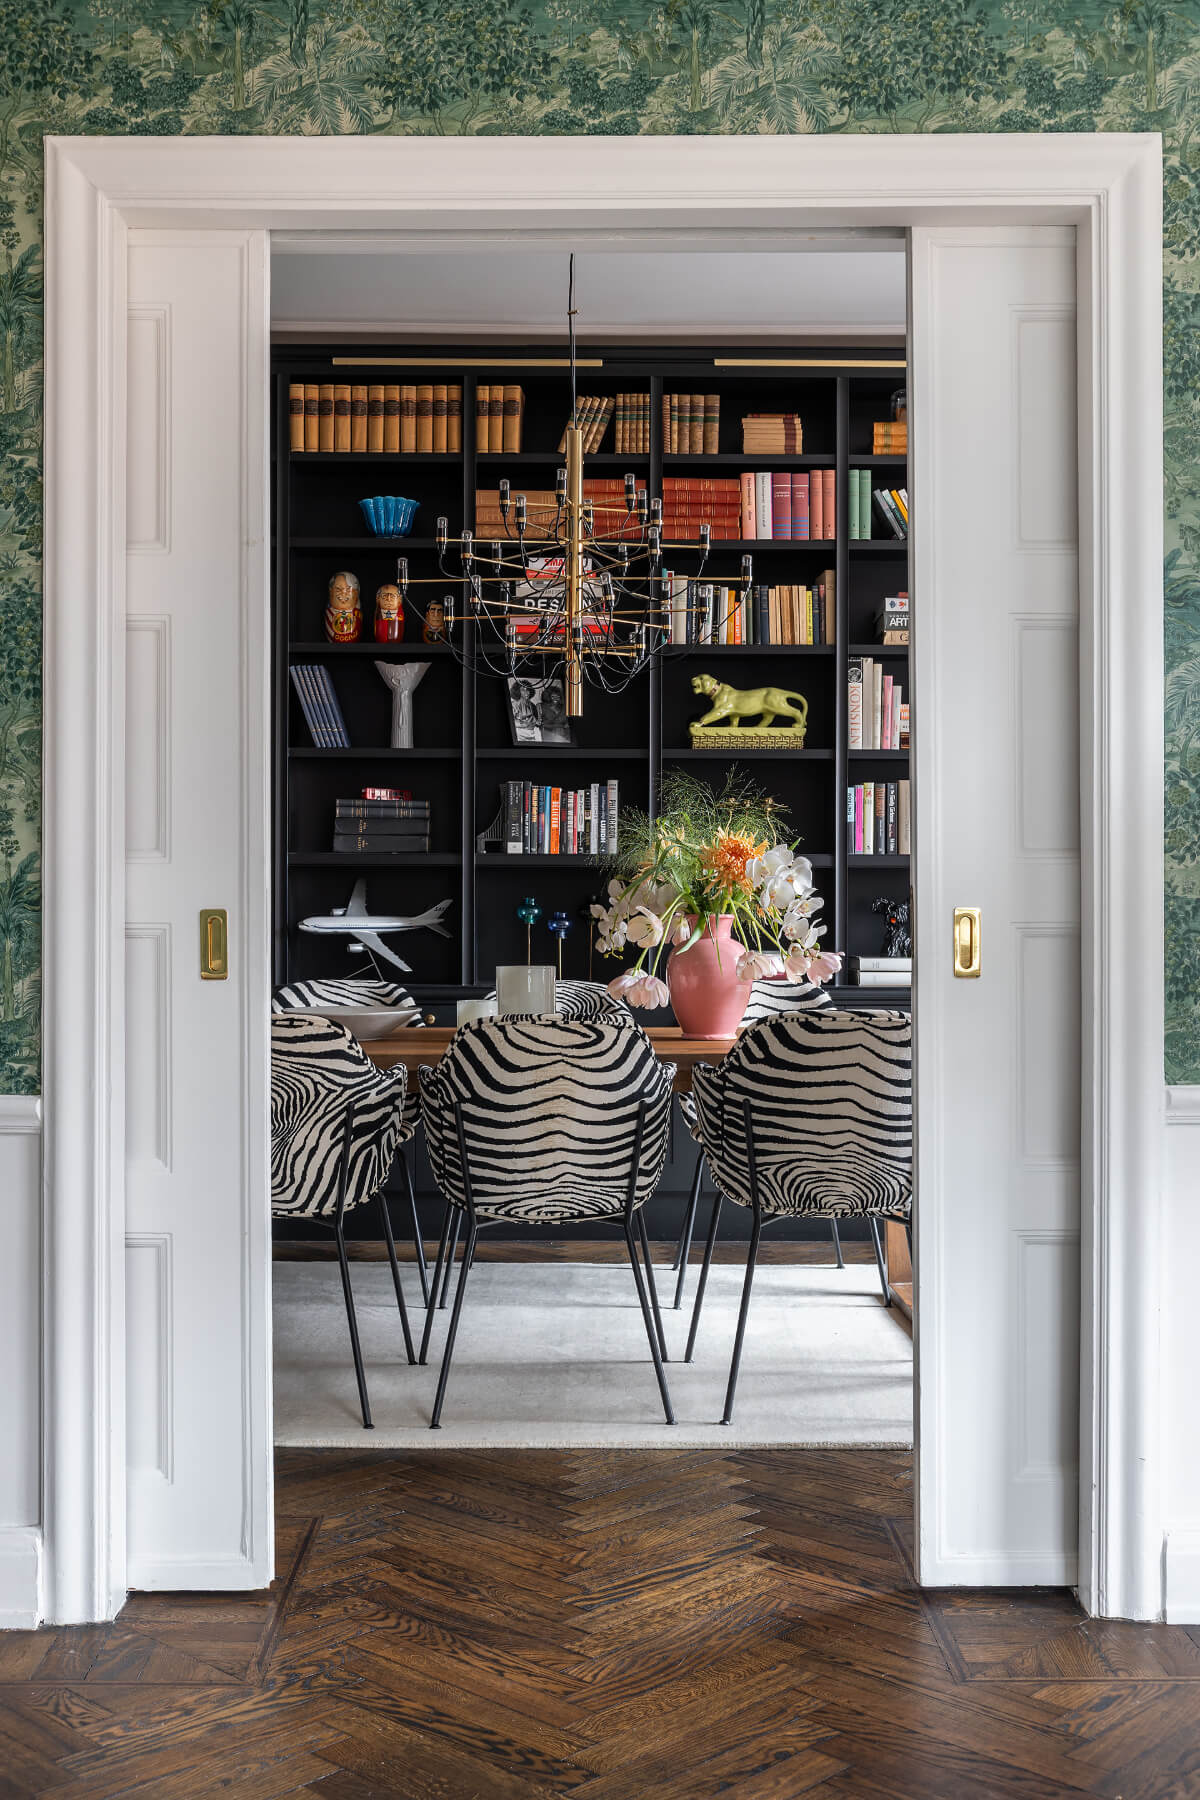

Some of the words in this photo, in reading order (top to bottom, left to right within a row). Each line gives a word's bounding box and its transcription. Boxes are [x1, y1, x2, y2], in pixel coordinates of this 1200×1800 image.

[524, 598, 593, 612] DESN
[608, 799, 617, 812] PHIL
[608, 813, 617, 839] JACKSON
